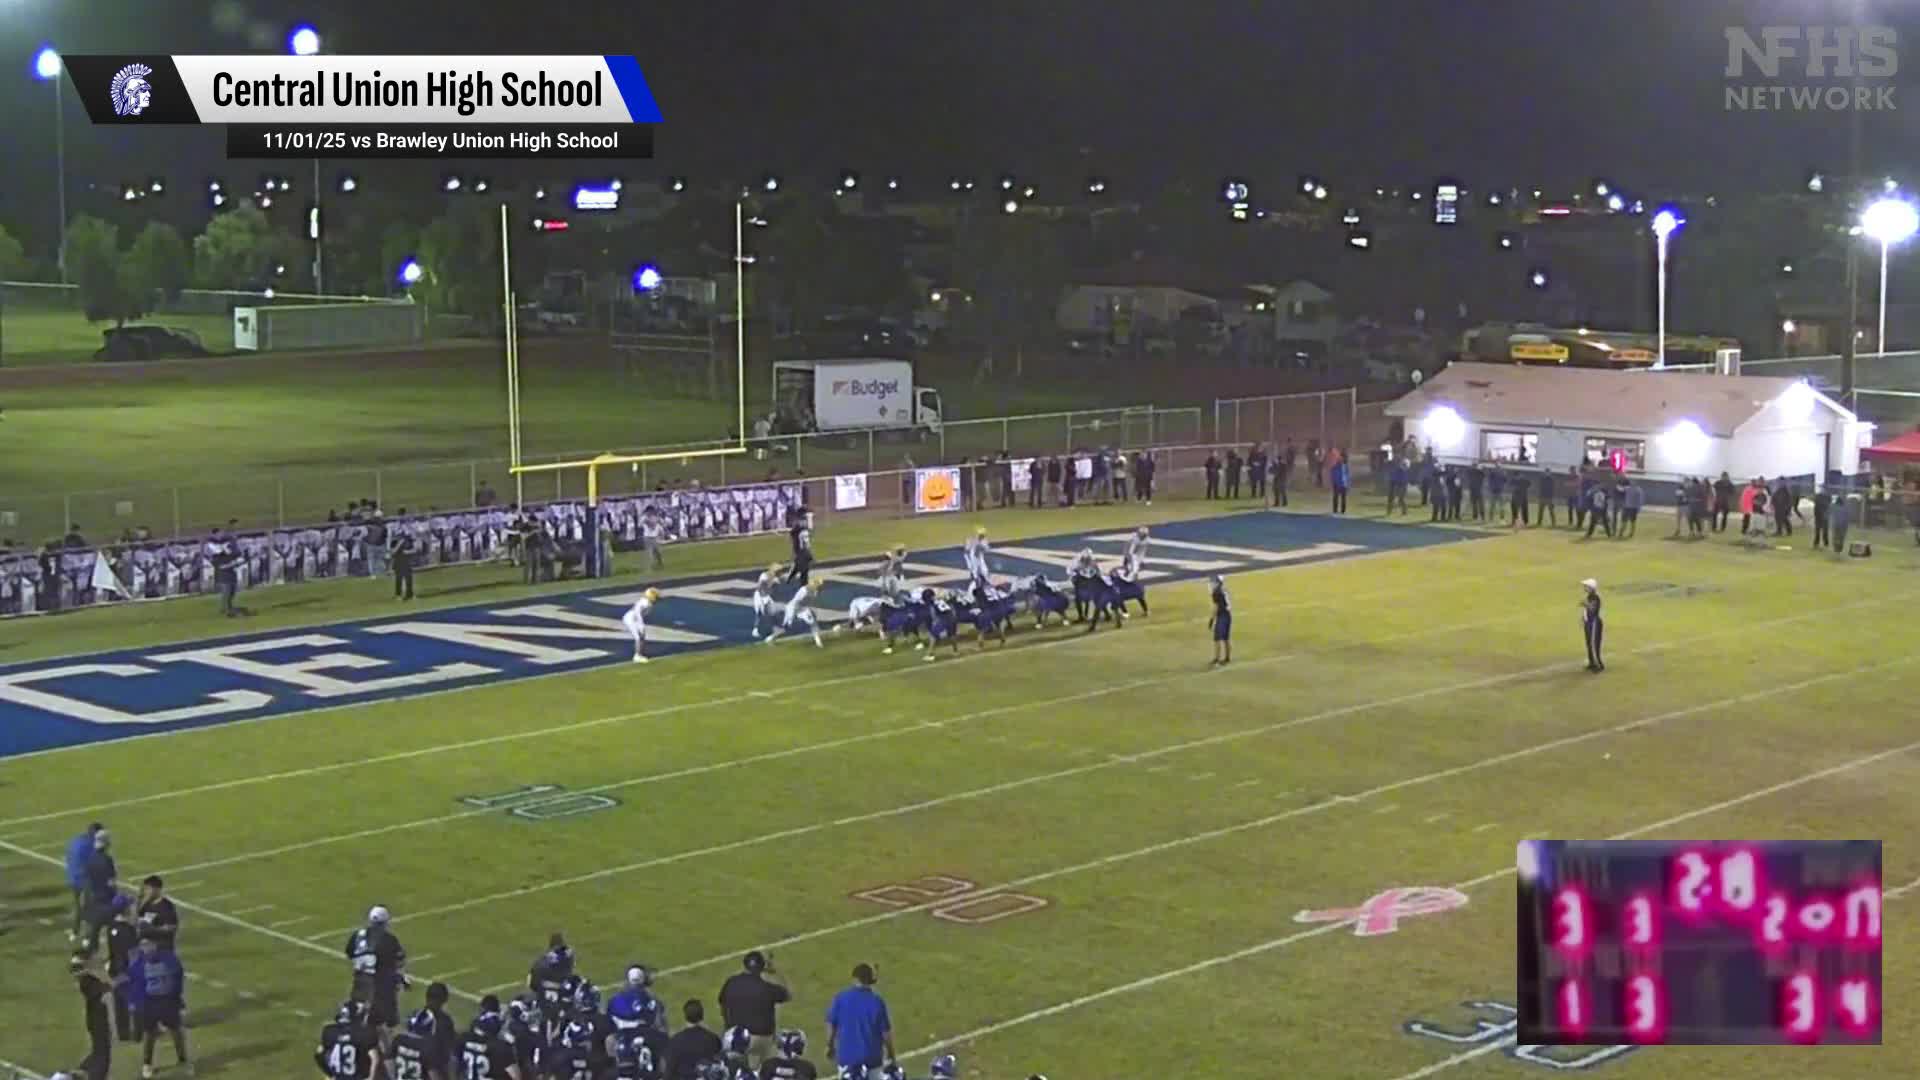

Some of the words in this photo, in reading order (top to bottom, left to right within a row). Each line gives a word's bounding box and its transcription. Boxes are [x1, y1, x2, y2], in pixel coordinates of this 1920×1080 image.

[851, 378, 898, 399] Budget
[849, 874, 1050, 925] 20
[330, 1043, 357, 1075] 43
